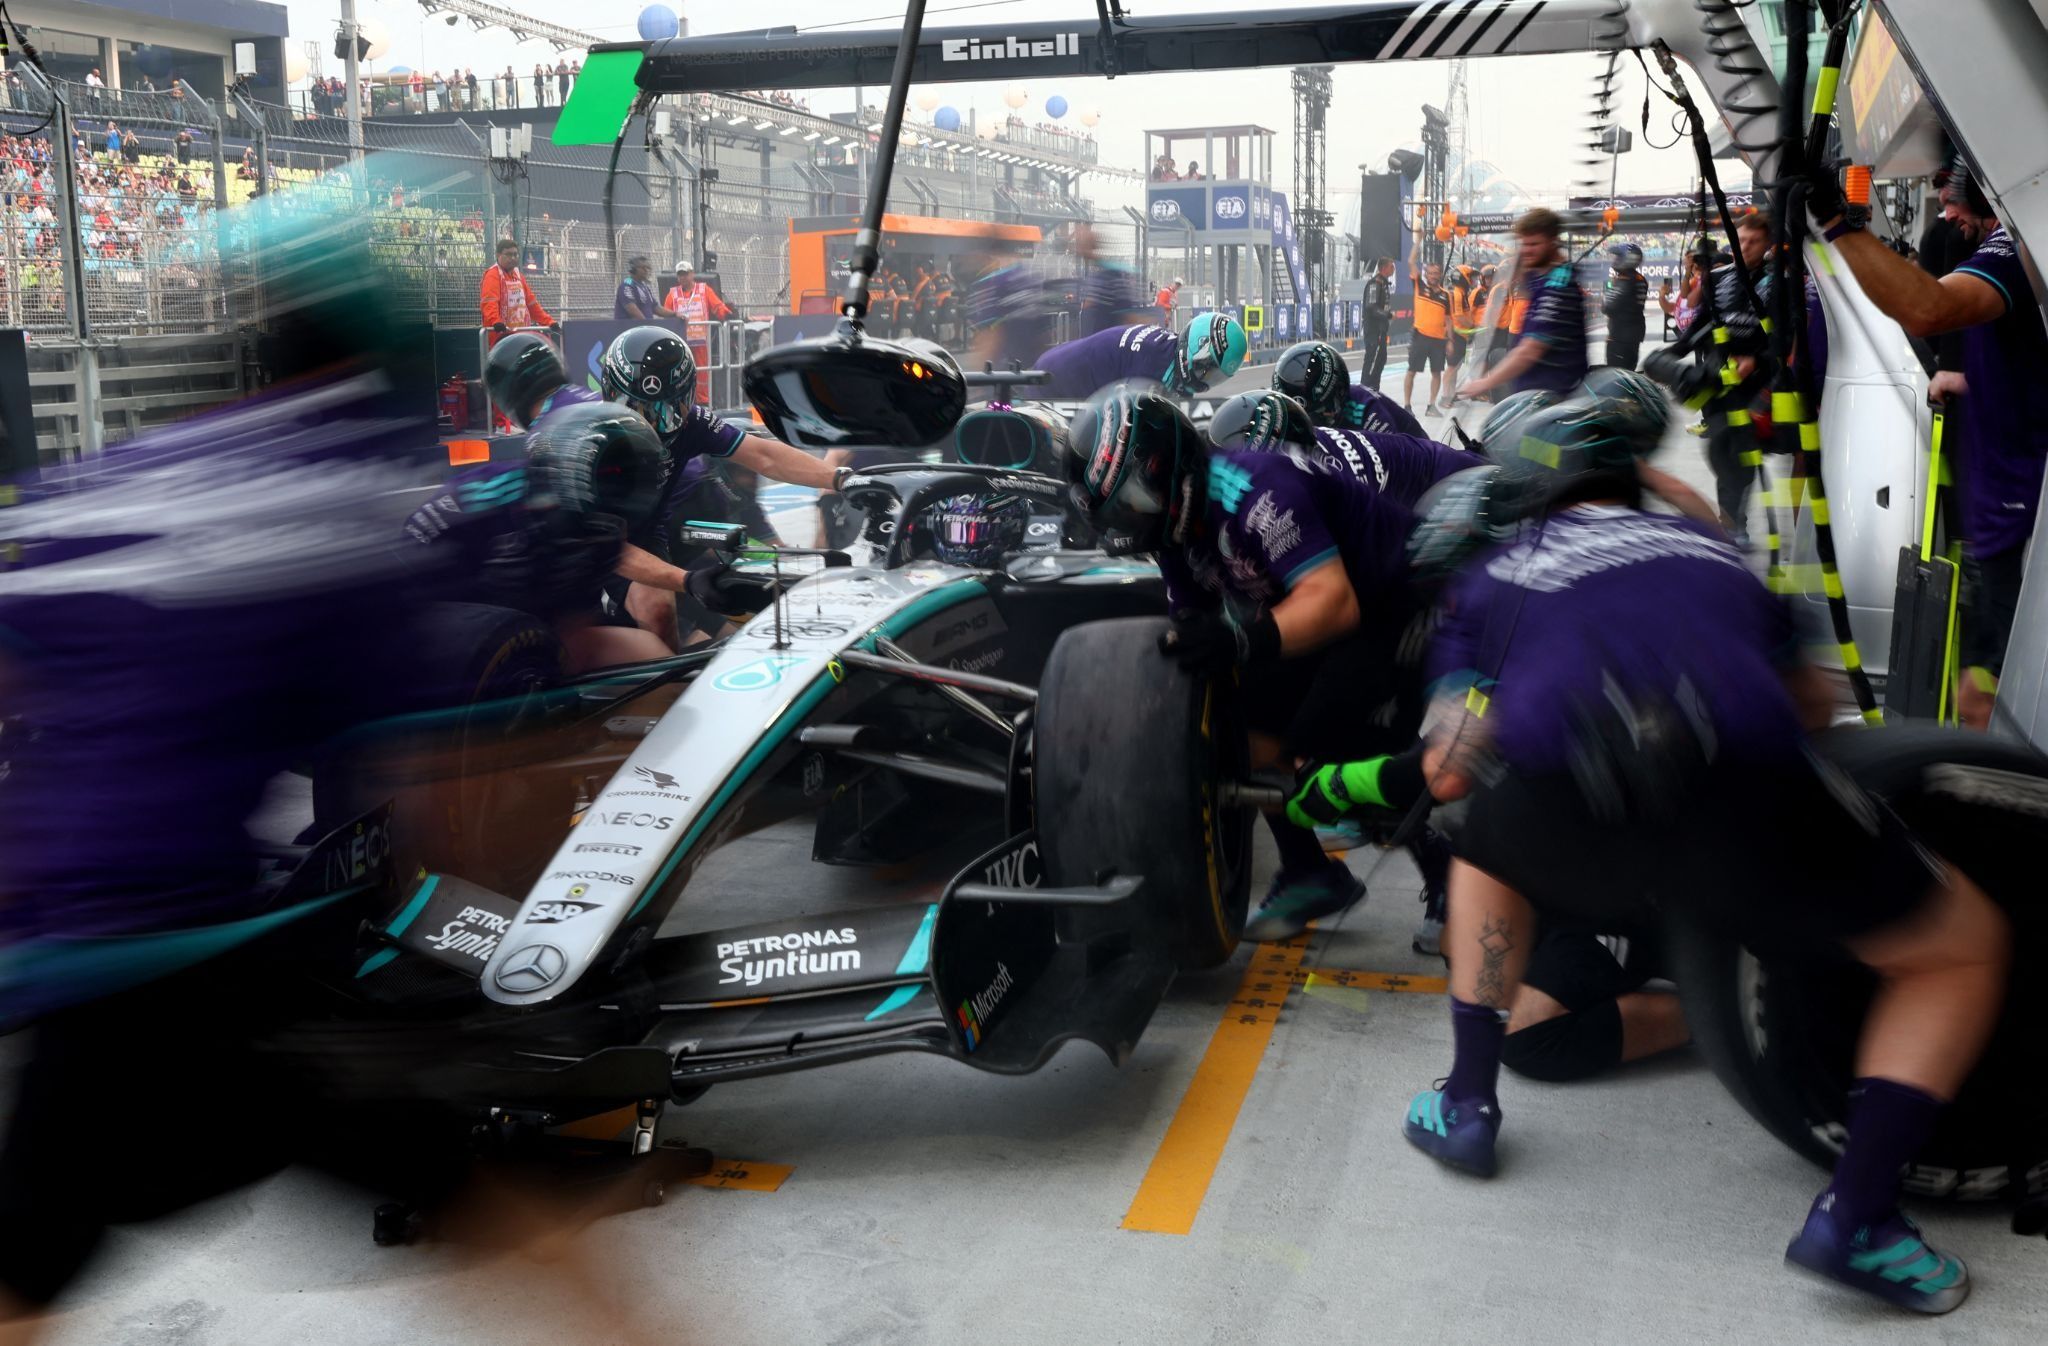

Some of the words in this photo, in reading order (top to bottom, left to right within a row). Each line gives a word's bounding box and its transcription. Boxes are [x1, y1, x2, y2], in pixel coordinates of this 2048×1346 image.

[769, 48, 840, 62] PETRONAS
[856, 45, 889, 57] Team
[942, 33, 1079, 61] Einhell
[690, 531, 728, 541] PETRONAS
[606, 790, 693, 802] CROWDSTRIKE
[584, 812, 675, 830] INEOS
[573, 843, 643, 856] PIRELLI
[456, 906, 513, 933] PETRO
[425, 921, 501, 961] Synti
[717, 928, 857, 959] PETRONAS
[719, 949, 861, 987] Syntium
[971, 961, 1014, 1026] Microsoft
